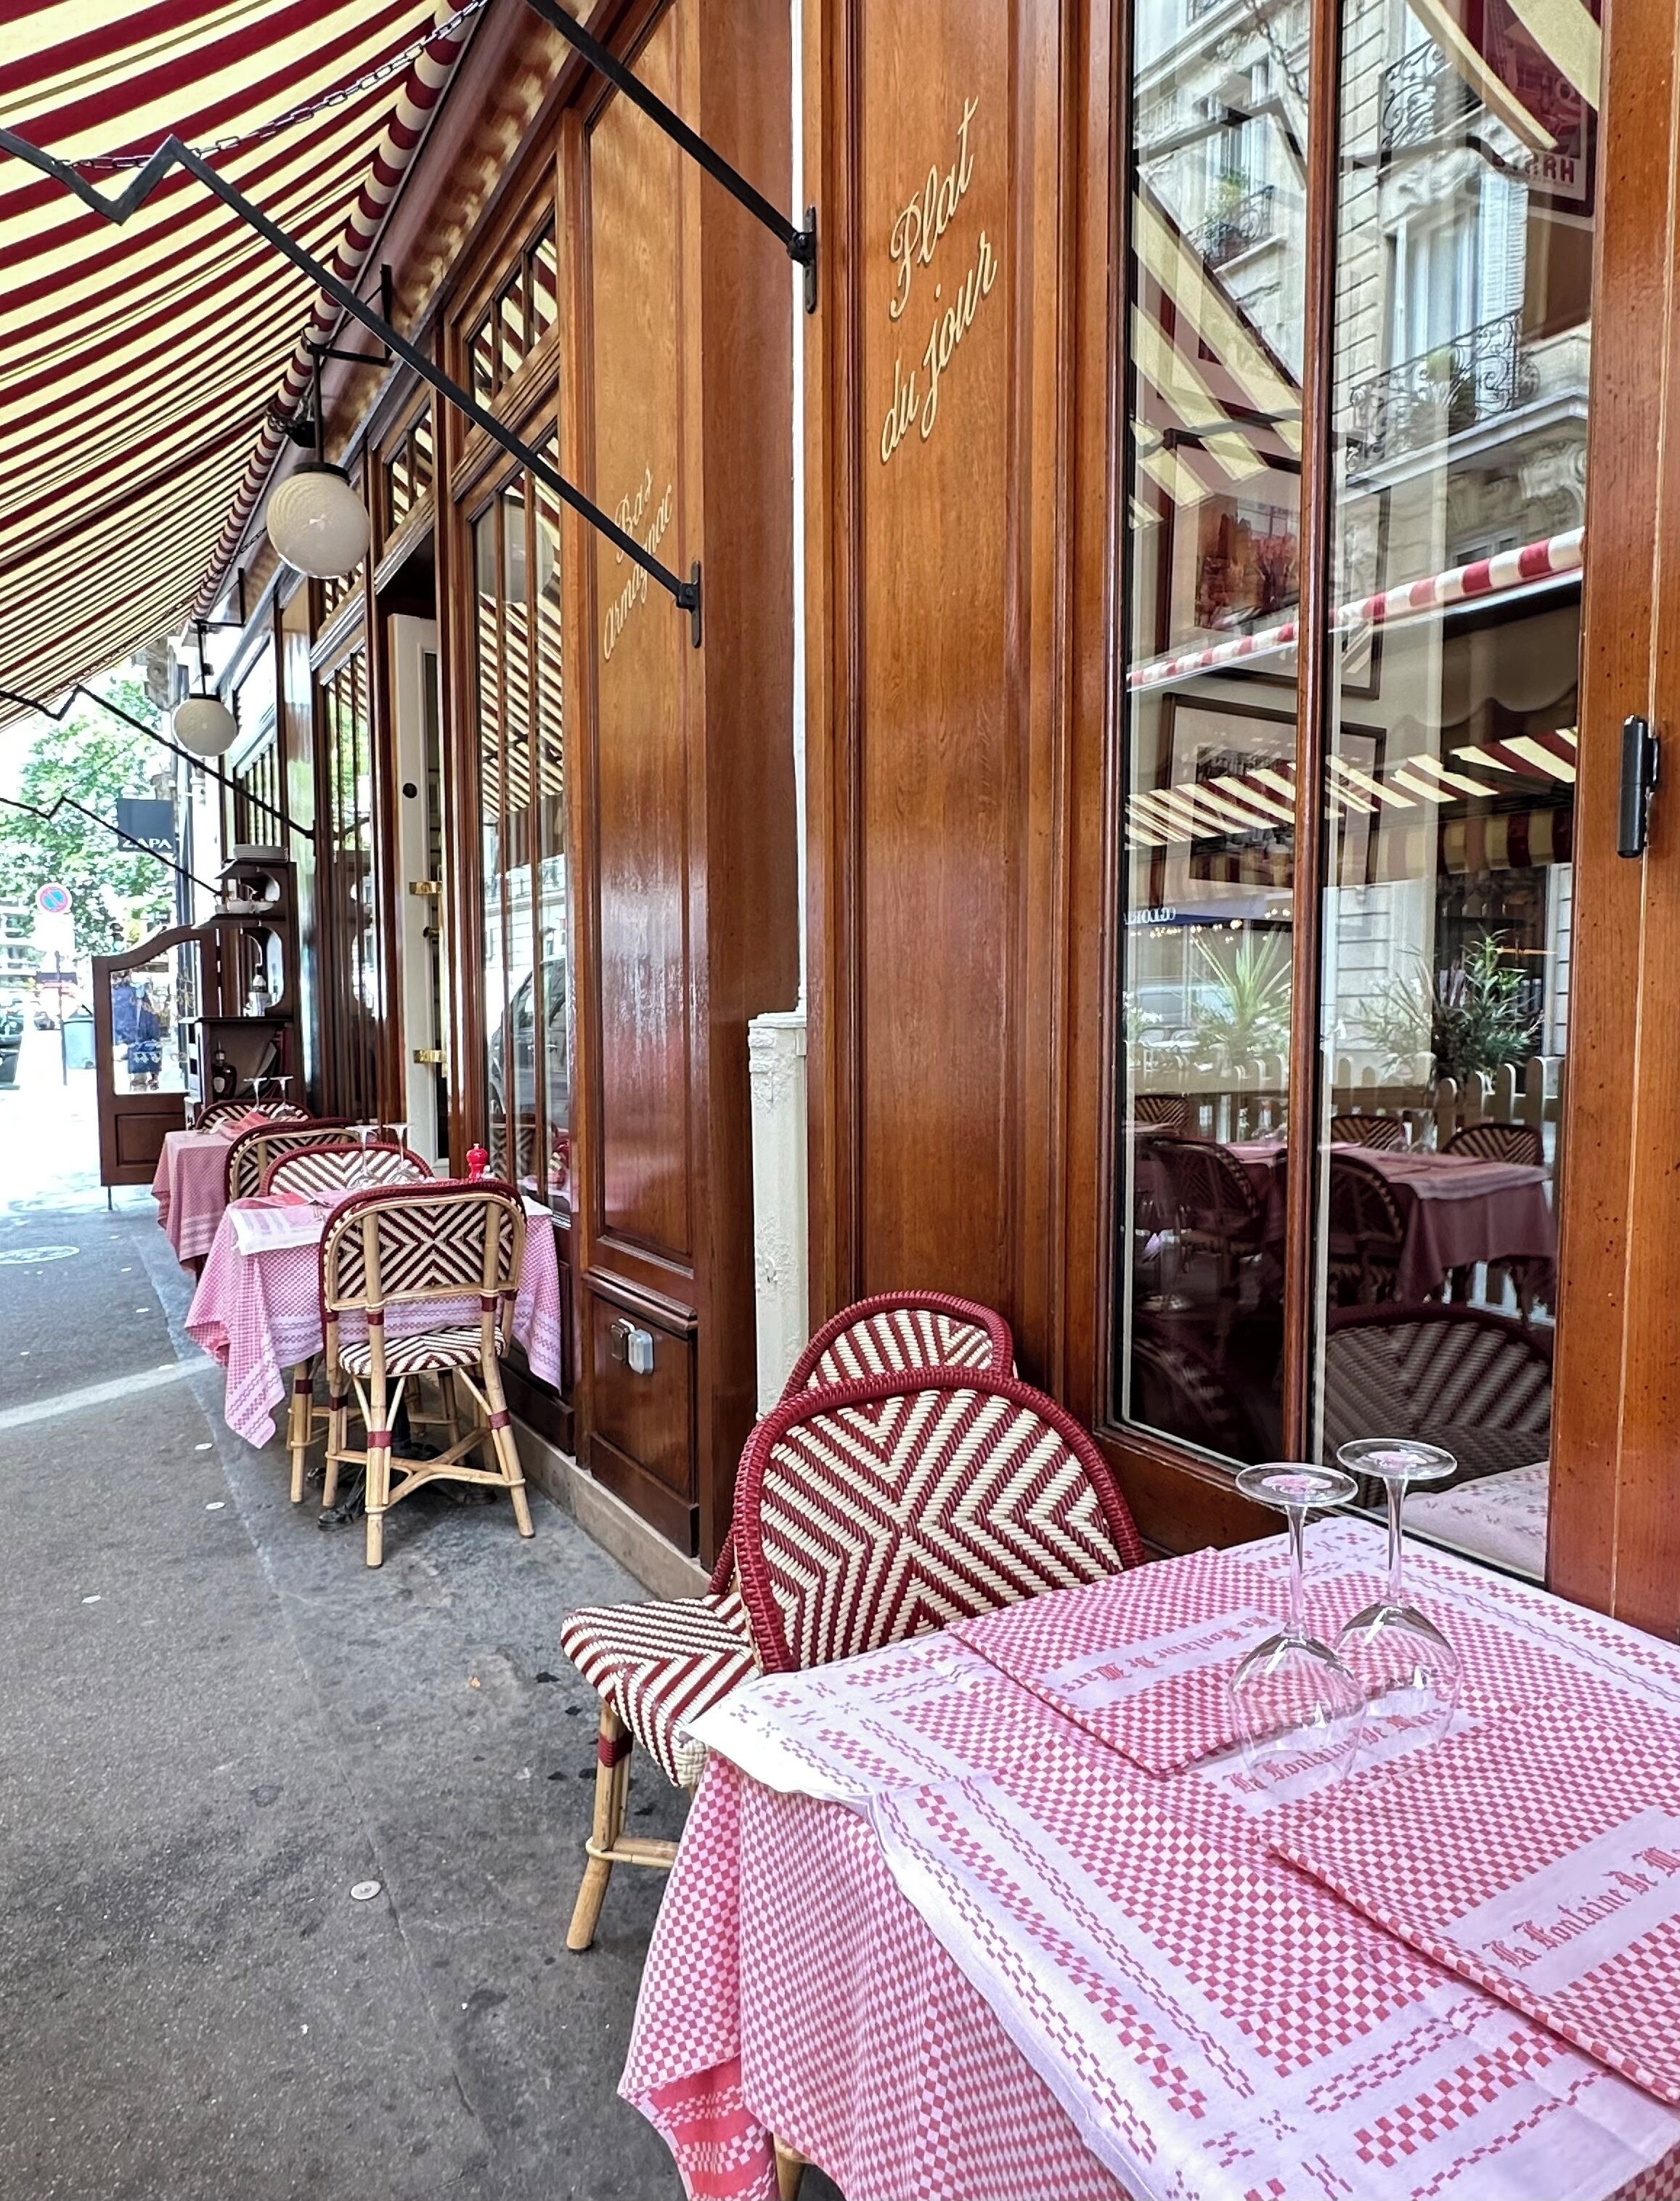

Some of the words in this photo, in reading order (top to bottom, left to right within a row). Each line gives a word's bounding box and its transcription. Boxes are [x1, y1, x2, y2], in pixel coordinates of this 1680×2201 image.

[889, 95, 979, 319] Plat
[881, 357, 919, 464] du
[921, 230, 998, 439] jour
[615, 461, 653, 564] Bas
[122, 837, 172, 849] ZAPA
[1237, 1615, 1276, 1629] La
[1153, 1629, 1251, 1659] Fontaine
[1060, 1662, 1133, 1693] Mars
[1223, 1772, 1268, 1794] La
[1481, 1940, 1542, 1970] La
[1512, 1888, 1632, 1950] Fontaine
